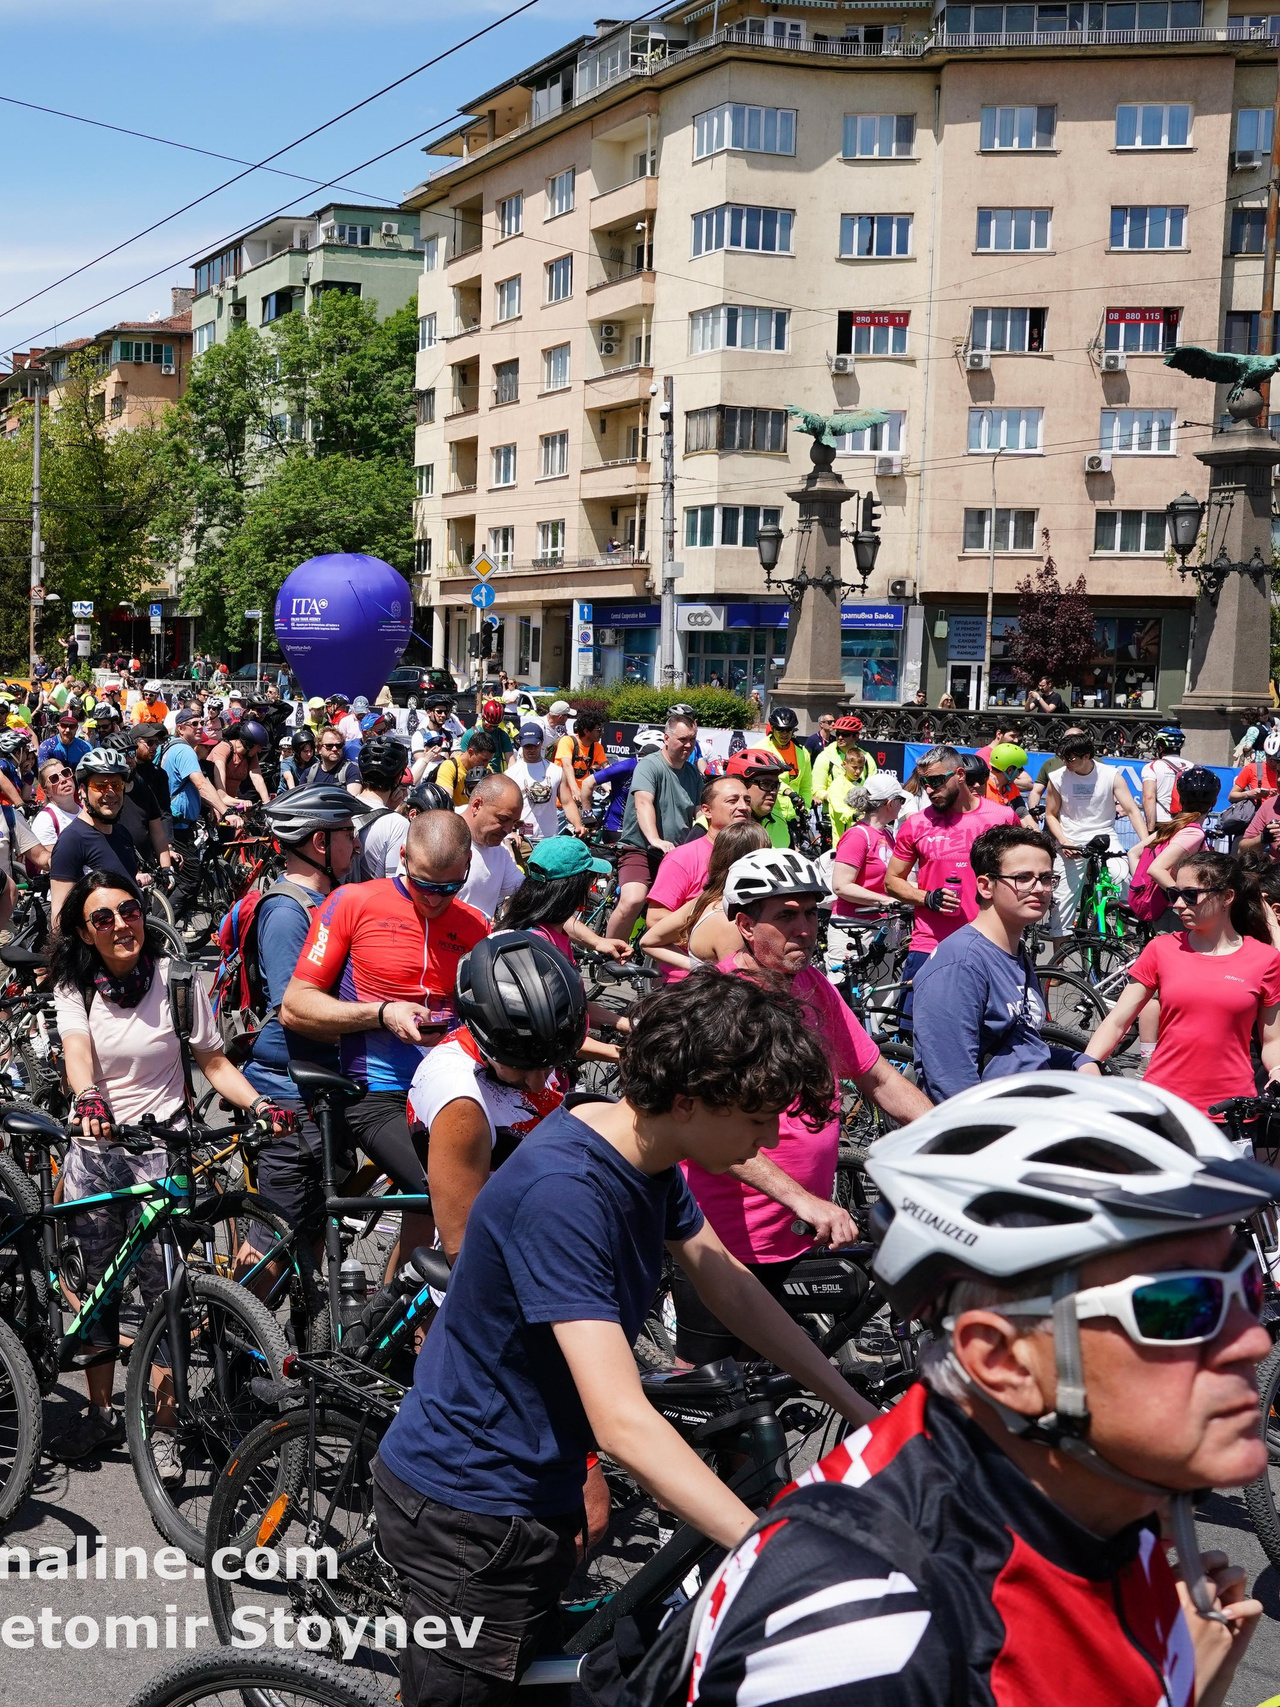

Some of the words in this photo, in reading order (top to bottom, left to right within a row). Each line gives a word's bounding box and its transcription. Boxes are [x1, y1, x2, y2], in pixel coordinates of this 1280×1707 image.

[291, 598, 321, 616] ITA
[874, 612, 895, 620] Банка
[606, 744, 631, 755] TUDOR
[877, 769, 898, 780] DOR
[307, 888, 347, 967] Fiberdeck
[901, 1196, 979, 1247] SPECIALIZED
